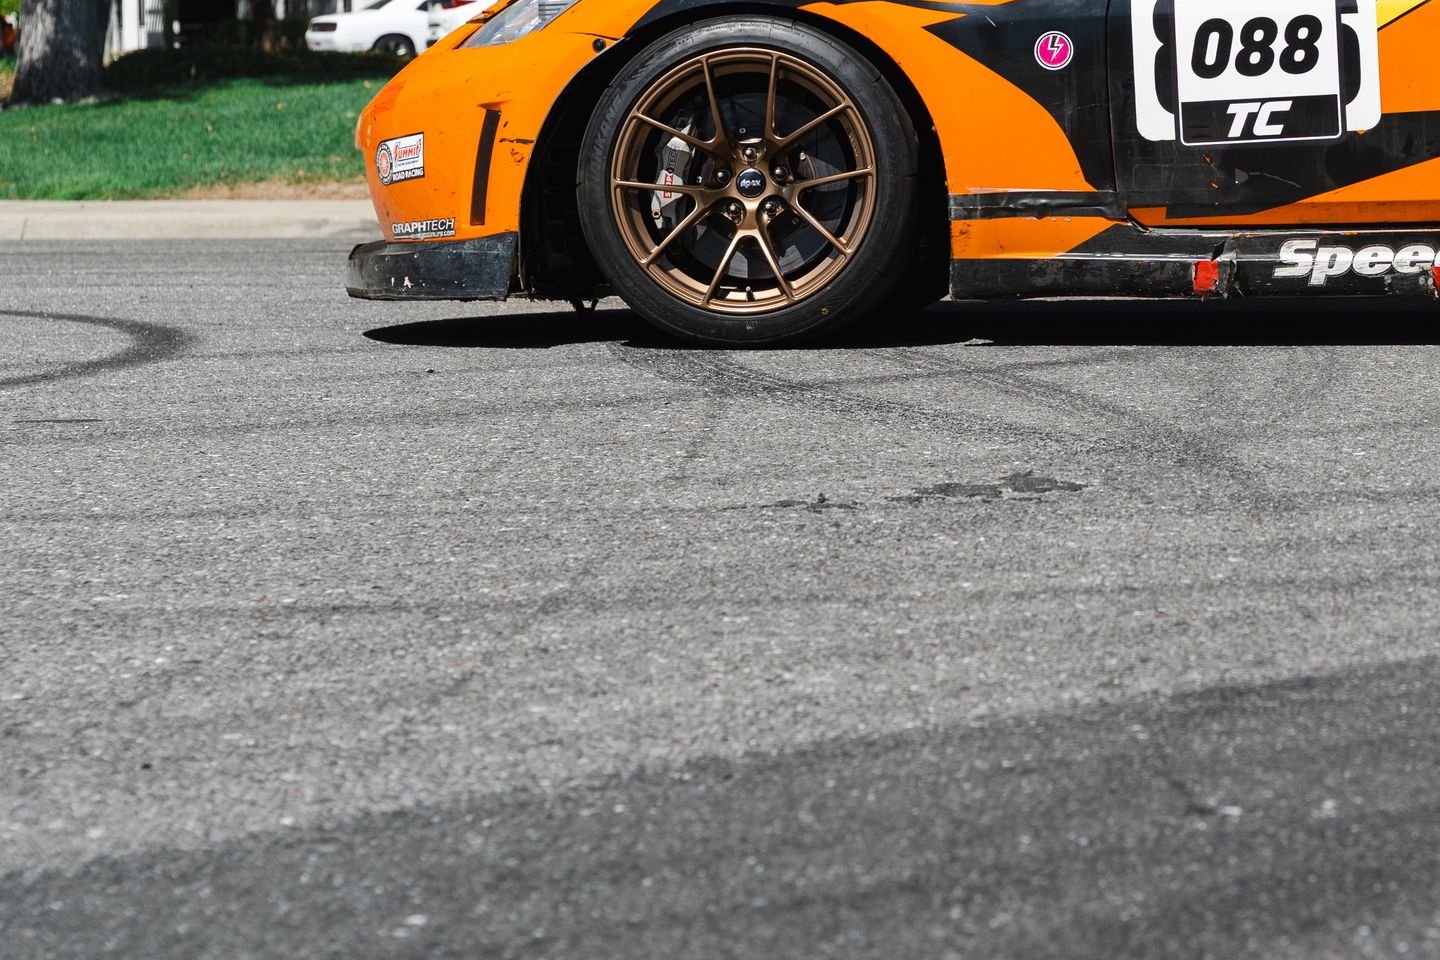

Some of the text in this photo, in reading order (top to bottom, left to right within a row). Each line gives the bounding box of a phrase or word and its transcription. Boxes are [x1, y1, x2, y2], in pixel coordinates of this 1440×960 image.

[1191, 14, 1323, 79] 088
[1226, 100, 1293, 138] TC
[392, 218, 455, 234] GRAPHTECH
